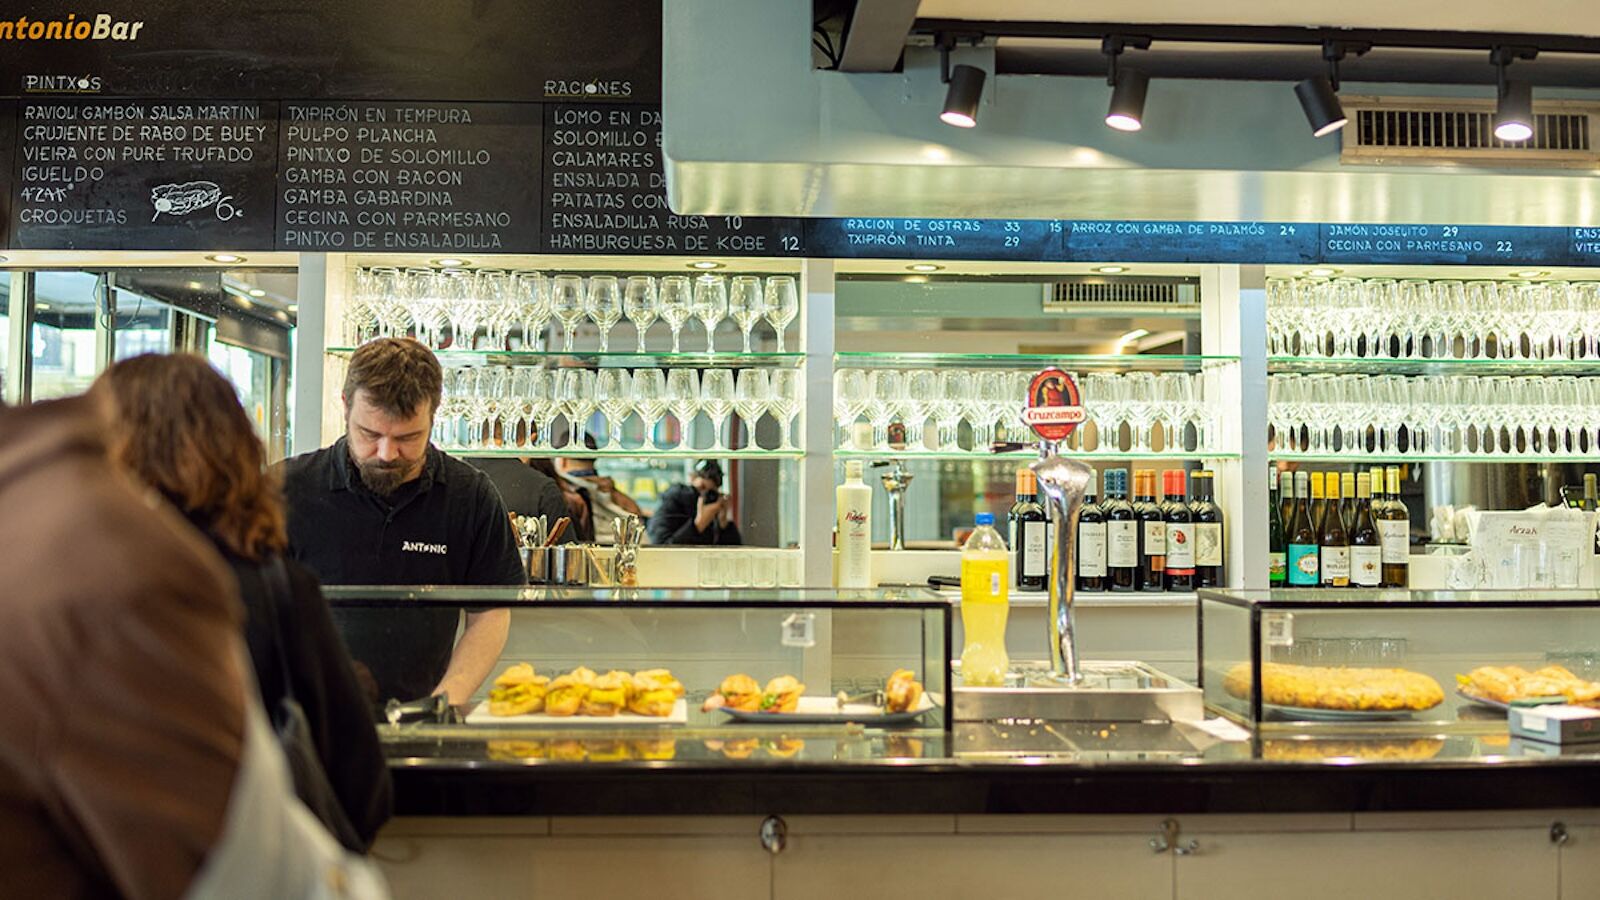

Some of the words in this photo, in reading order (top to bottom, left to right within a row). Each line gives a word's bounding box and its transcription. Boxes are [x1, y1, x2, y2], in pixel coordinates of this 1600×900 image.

[26, 75, 101, 90] PINTXOS
[544, 80, 632, 95] RACIONES
[25, 106, 77, 120] RAVIOLI
[82, 103, 144, 120] GAMBÓN
[150, 106, 193, 120] SALSA
[198, 106, 260, 120] MARTINI
[288, 105, 359, 122] TXIPIRÓN
[365, 108, 386, 122] EN
[395, 108, 472, 124] TEMPURA
[554, 110, 602, 125] LOMO
[609, 112, 631, 125] EN
[24, 126, 107, 141] CRUJIENTE
[112, 126, 134, 141] DE
[140, 126, 186, 141] RABO
[193, 126, 214, 141] DE
[220, 126, 266, 141] BUEY
[288, 127, 349, 142] PULPO
[357, 128, 437, 143] PLANCHA
[552, 131, 648, 147] SOLOMILLO
[23, 147, 77, 161] VIEIRA
[84, 147, 115, 161] CON
[122, 144, 165, 161] PURÉ
[173, 147, 253, 162] TRUFADO
[287, 148, 351, 164] PINTXO
[360, 149, 383, 163] DE
[390, 149, 490, 165] SOLOMILLO
[552, 152, 654, 168] CALAMARES
[22, 166, 104, 182] IGUELDO
[286, 168, 347, 184] GAMBA
[352, 170, 389, 184] CON
[397, 170, 462, 185] BACON
[553, 173, 640, 188] ENSALADA
[284, 189, 348, 205] GAMBA
[353, 190, 453, 206] GABARDINA
[552, 193, 625, 209] PATATAS
[632, 194, 668, 209] CON
[20, 209, 127, 226] CROQUETAS
[285, 210, 350, 225] CECINA
[357, 211, 396, 225] CON
[404, 211, 511, 227] PARMESANO
[552, 213, 660, 230] ENSALADILLA
[667, 215, 709, 230] RUSA
[725, 216, 743, 230] 10
[904, 219, 921, 230] DE
[928, 220, 981, 231] OSTRAS
[1004, 222, 1020, 232] 33
[1072, 222, 1111, 233] ARROZ
[1116, 223, 1140, 234] CON
[1143, 223, 1183, 234] GAMBA
[1188, 224, 1204, 234] DE
[1210, 222, 1265, 235] PALAMÓS
[1280, 225, 1296, 236] 24
[1329, 224, 1369, 236] JAMÓN
[1373, 226, 1428, 237] JOSELITO
[1443, 226, 1458, 238] 29
[286, 231, 345, 246] PINTXO
[353, 232, 376, 246] DE
[384, 231, 502, 248] ENSALADILLA
[550, 234, 676, 250] HAMBURGUESA
[685, 236, 708, 250] DE
[716, 236, 765, 250] KOBE
[781, 236, 800, 250] 12
[848, 232, 906, 245] TXIPIRÓN
[917, 235, 955, 246] TINTA
[1004, 236, 1020, 247] 29
[1327, 240, 1372, 250] CECINA
[1376, 241, 1401, 251] CON
[1407, 241, 1483, 251] PARMESANO
[1496, 241, 1512, 252] 22
